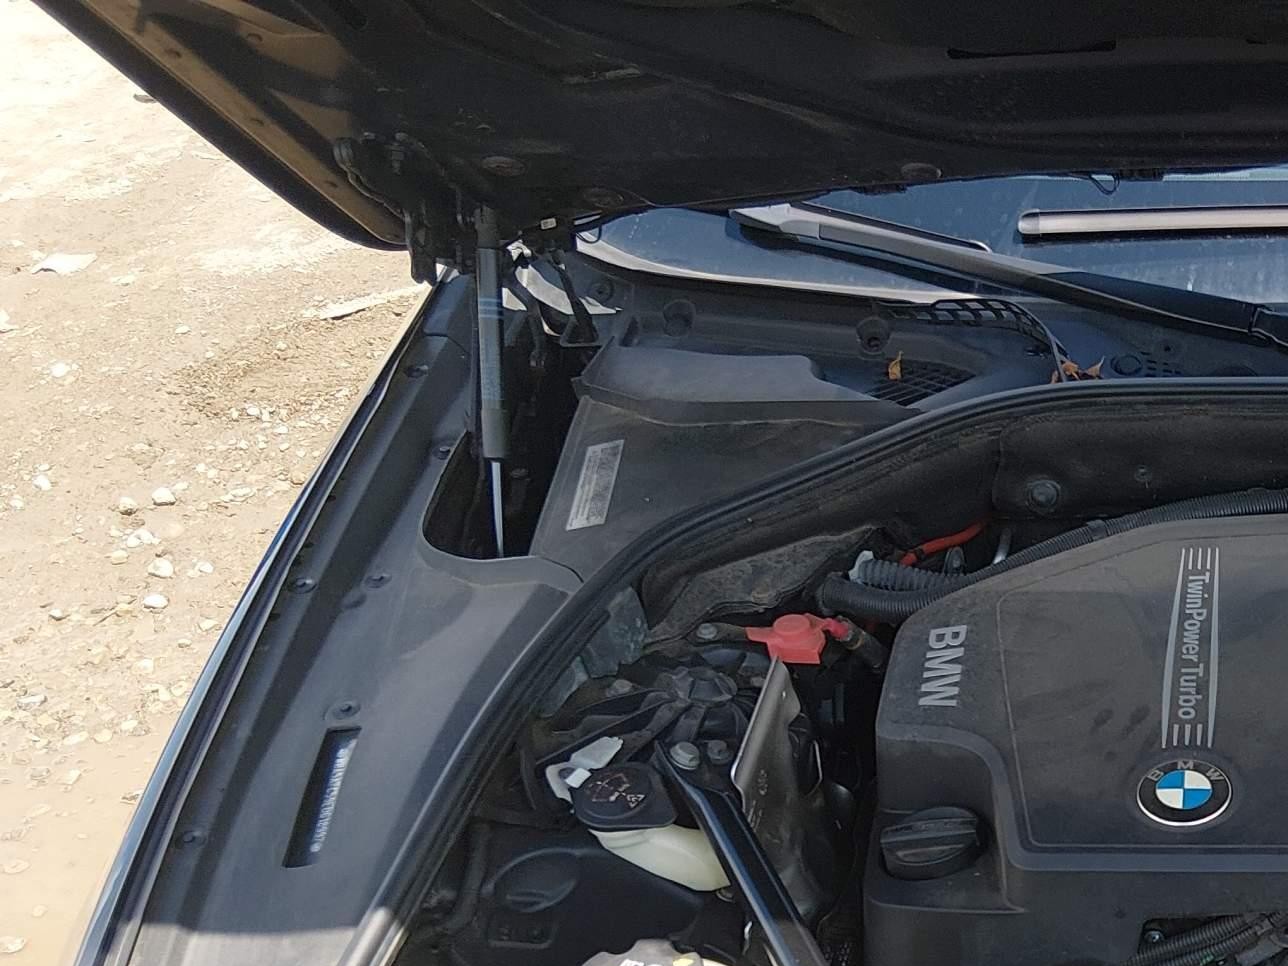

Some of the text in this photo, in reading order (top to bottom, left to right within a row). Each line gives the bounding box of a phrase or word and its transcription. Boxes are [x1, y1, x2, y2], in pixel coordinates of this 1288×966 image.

[918, 624, 967, 707] BMW
[1178, 571, 1211, 720] TwinPower Turbo
[1146, 760, 1225, 781] BMW
